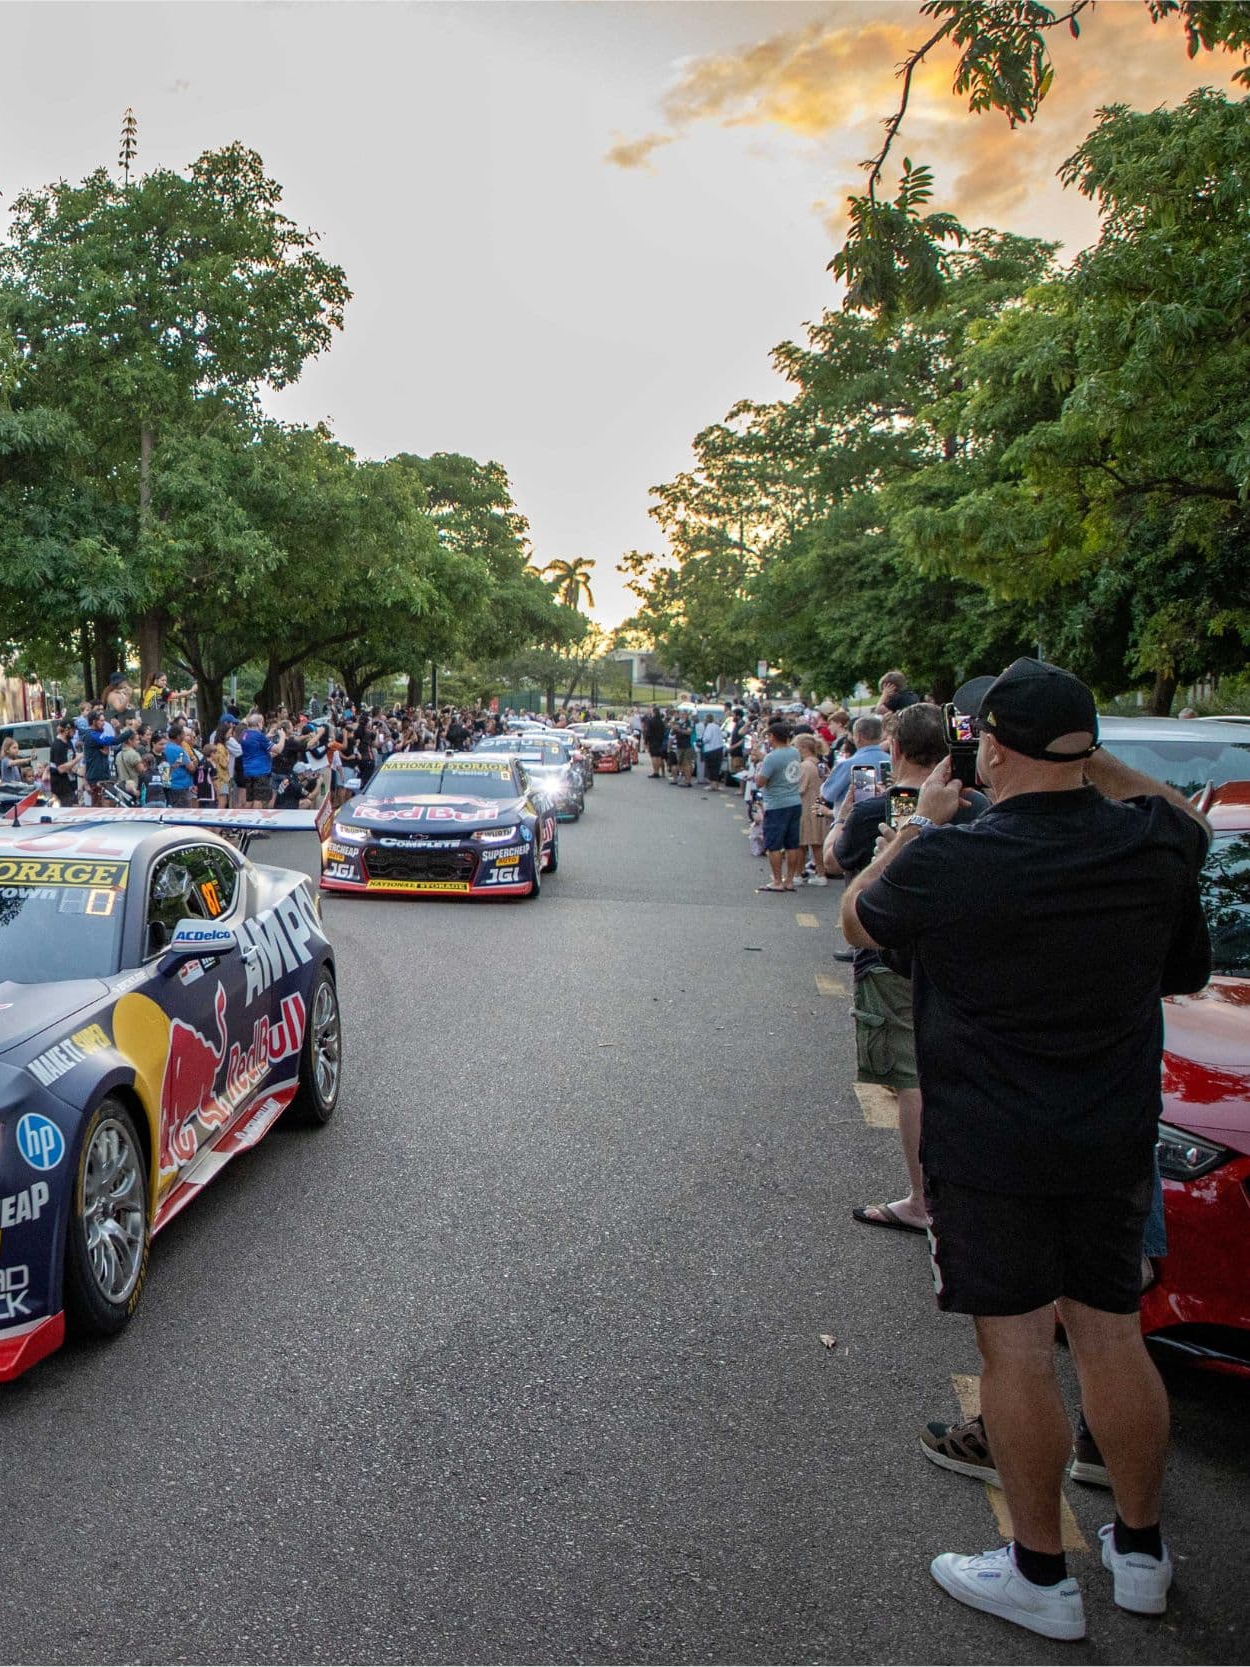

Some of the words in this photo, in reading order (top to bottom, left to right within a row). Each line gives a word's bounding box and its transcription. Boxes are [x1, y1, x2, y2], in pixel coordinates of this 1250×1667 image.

[353, 806, 425, 820] Red
[425, 806, 499, 822] Bull
[482, 843, 530, 862] SUPERCHEAP
[497, 855, 518, 865] AUTO
[486, 866, 519, 884] JGI
[175, 930, 231, 941] ACDelco
[21, 1116, 56, 1168] hp
